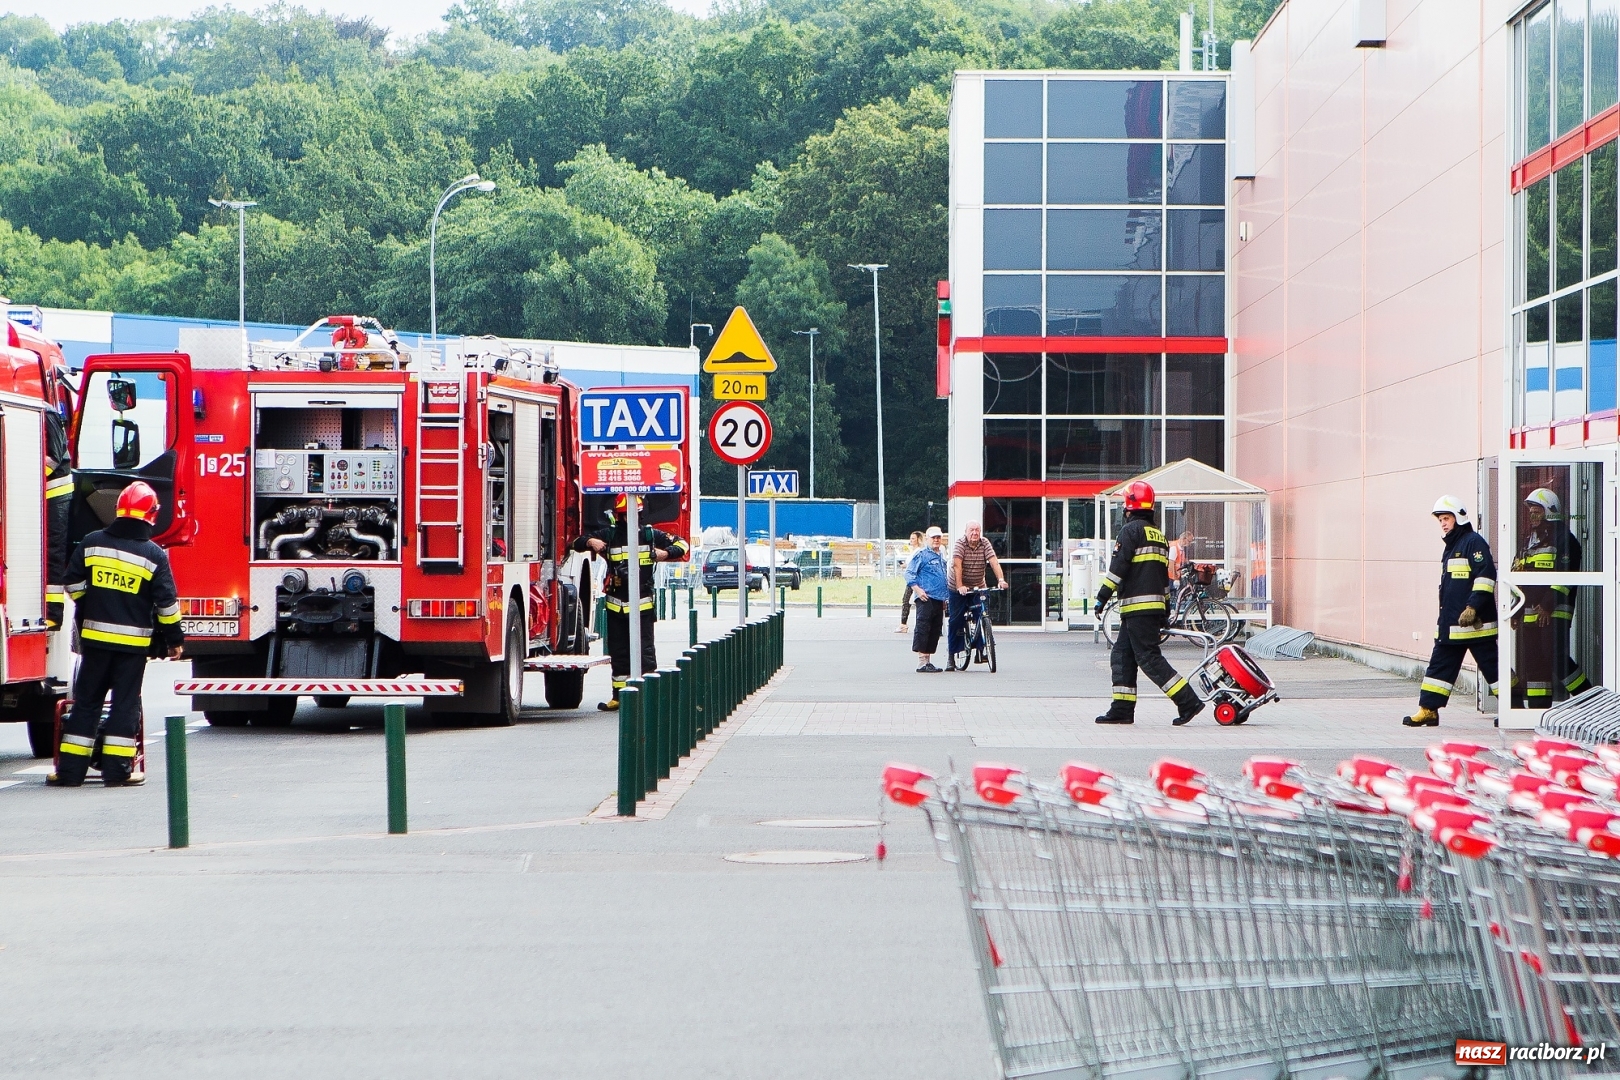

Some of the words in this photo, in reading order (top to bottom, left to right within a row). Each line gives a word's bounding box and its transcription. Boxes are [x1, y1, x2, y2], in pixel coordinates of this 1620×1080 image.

[722, 379, 742, 395] 20
[745, 384, 759, 395] m
[583, 398, 678, 437] TAXI
[721, 418, 763, 448] 20
[750, 474, 797, 494] TAXI
[180, 621, 204, 633] SRC
[208, 621, 237, 633] 21TR
